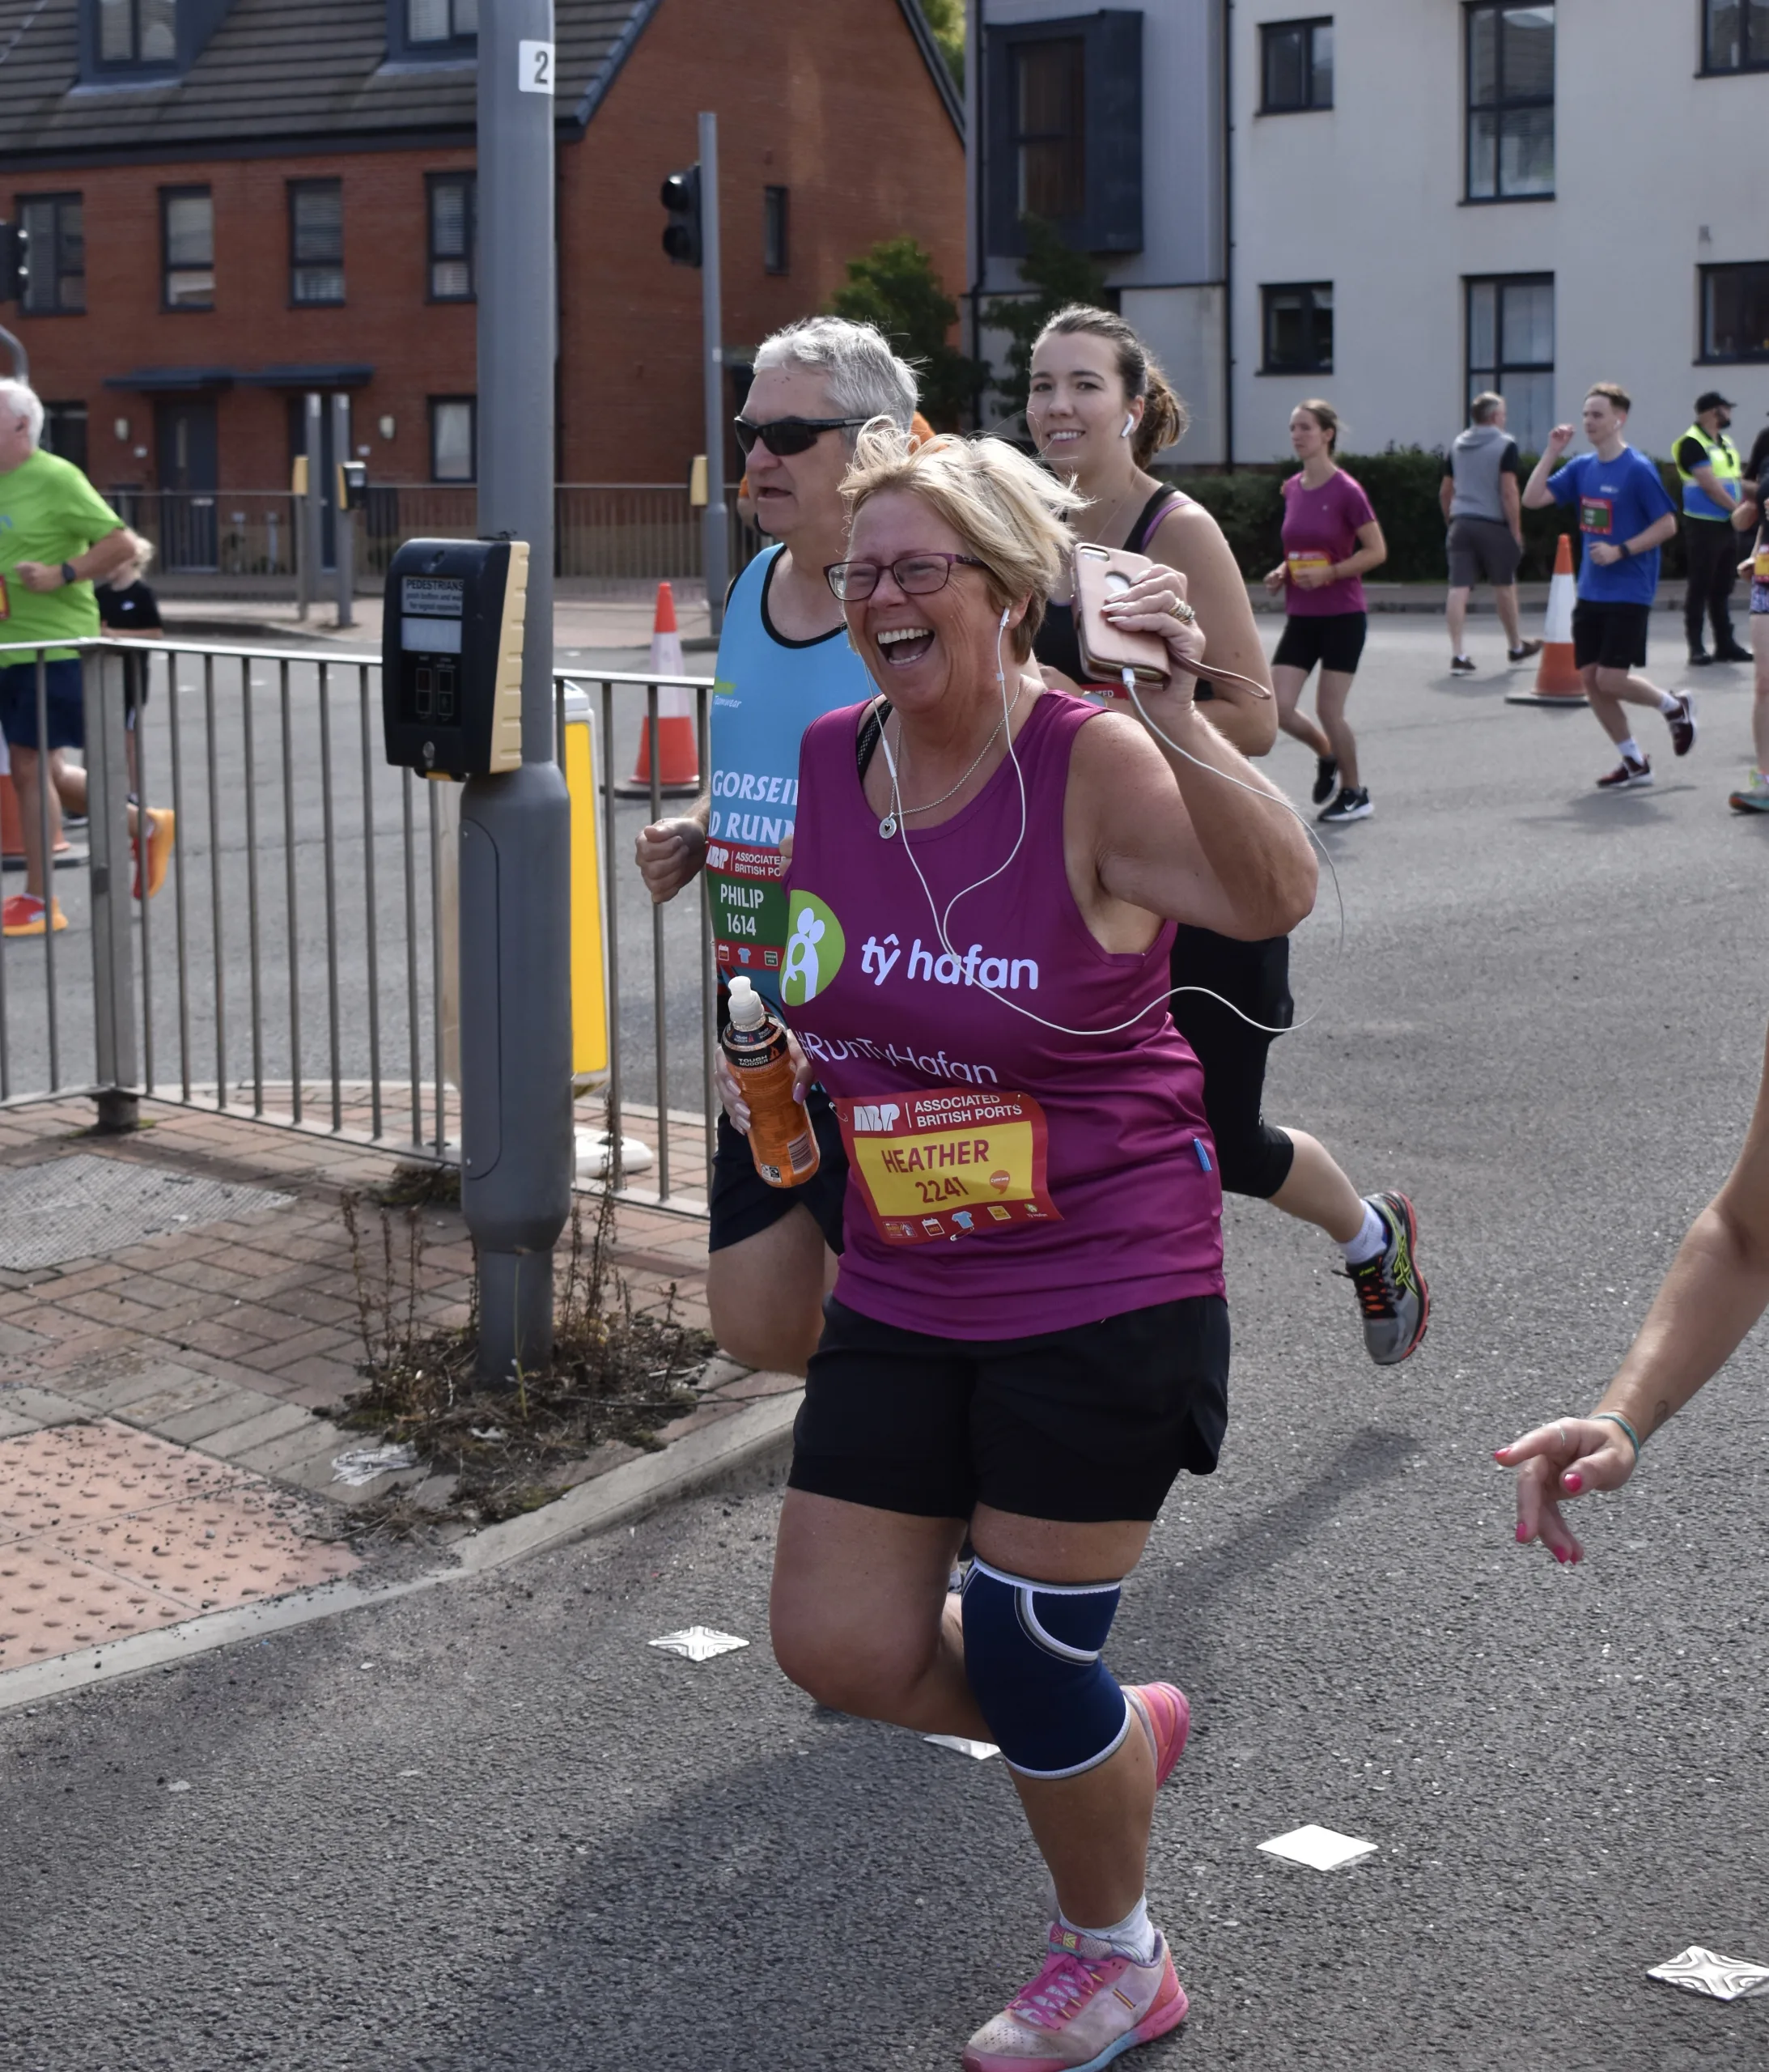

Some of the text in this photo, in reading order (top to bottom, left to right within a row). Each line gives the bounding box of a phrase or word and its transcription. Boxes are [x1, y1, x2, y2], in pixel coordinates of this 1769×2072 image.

[534, 50, 549, 85] 2
[407, 580, 464, 591] PEDESTRIANS
[735, 863, 766, 876] BRITISH
[720, 883, 764, 909] PHILIP
[727, 912, 757, 936] 1614
[861, 933, 1039, 990] tŷ hafan
[738, 1055, 767, 1063] TOUGH
[914, 1094, 1000, 1113] ASSOCIATED
[917, 1104, 1023, 1127] BRITISH PORTS
[880, 1139, 990, 1174] HEATHER
[914, 1176, 969, 1204] 2241
